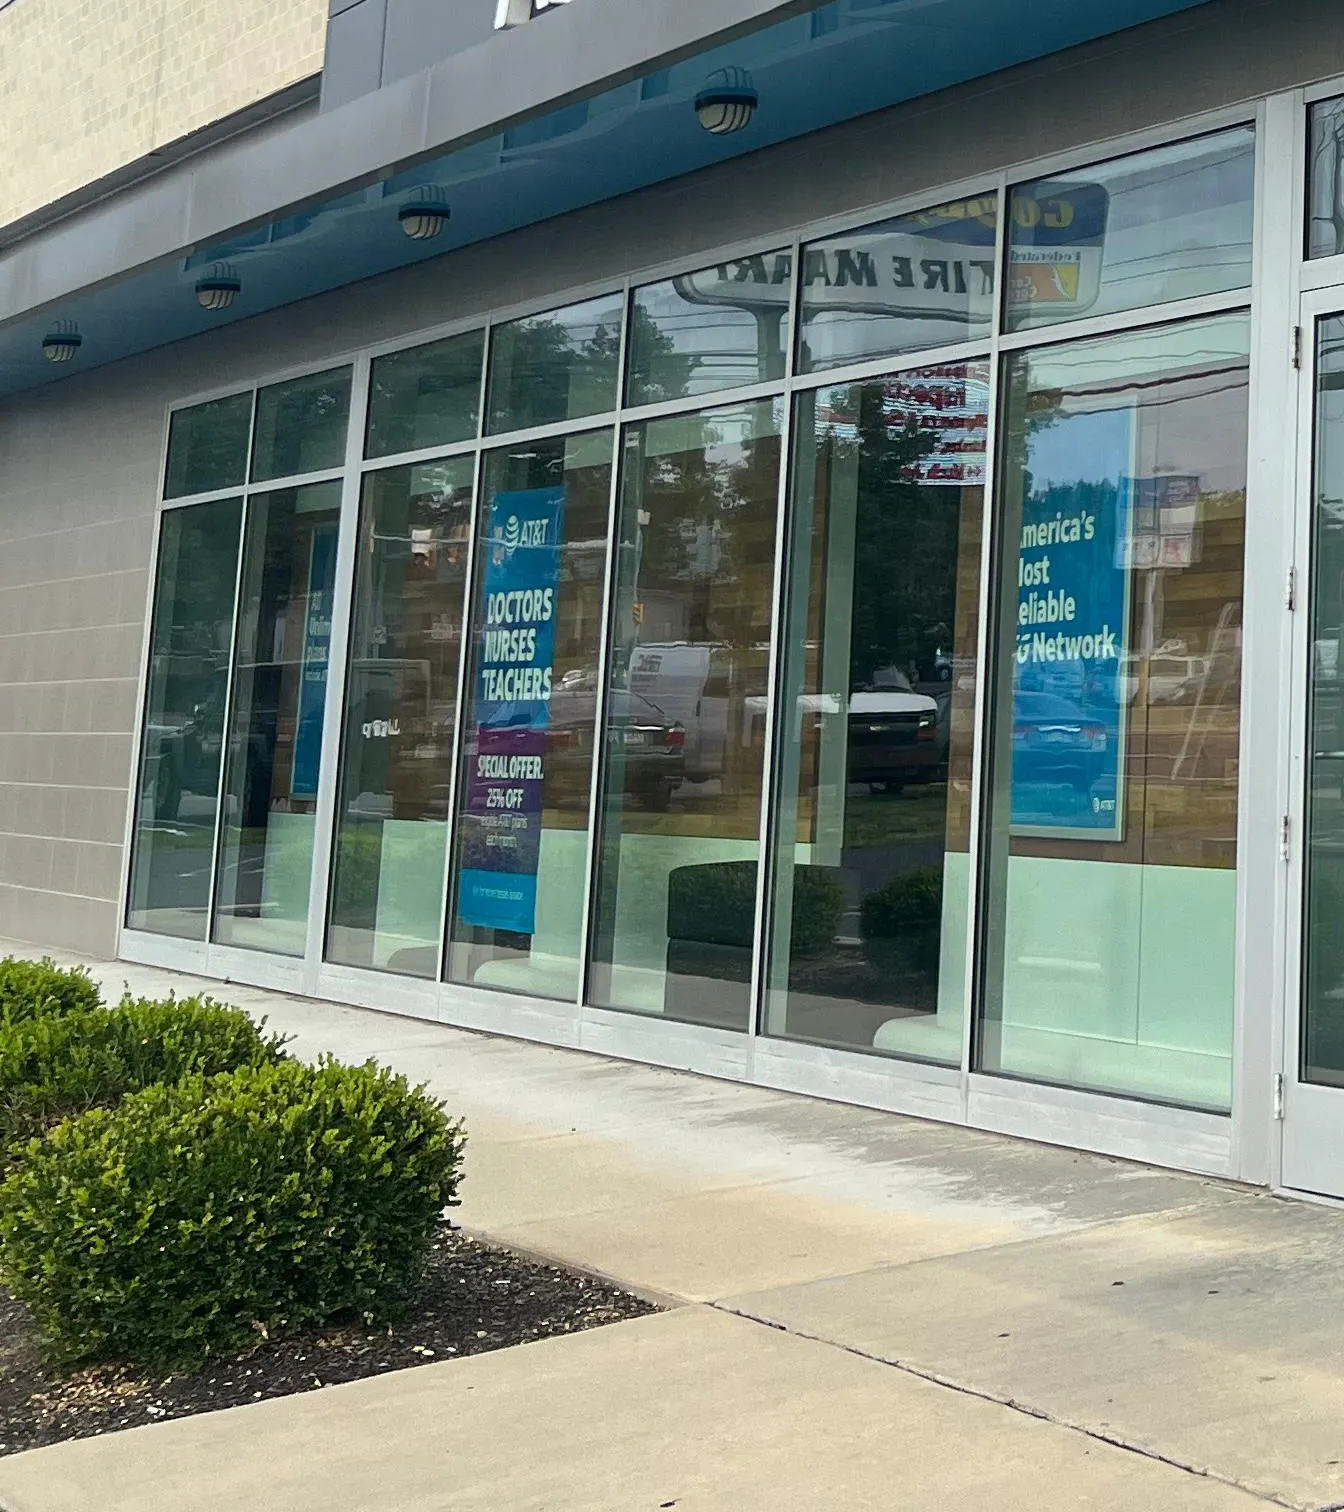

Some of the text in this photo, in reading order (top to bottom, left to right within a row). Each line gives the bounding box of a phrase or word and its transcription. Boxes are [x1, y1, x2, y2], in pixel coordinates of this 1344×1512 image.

[519, 519, 549, 546] AT&T
[1020, 510, 1095, 549] merica's
[487, 588, 553, 625] DOCTORS
[1017, 589, 1076, 626] eliable
[484, 628, 537, 663] NURSES
[1032, 624, 1116, 663] Network
[482, 667, 552, 701] TEACHERS
[477, 755, 544, 779] SPECIAL OFFER.
[486, 788, 525, 809] 25% OFF
